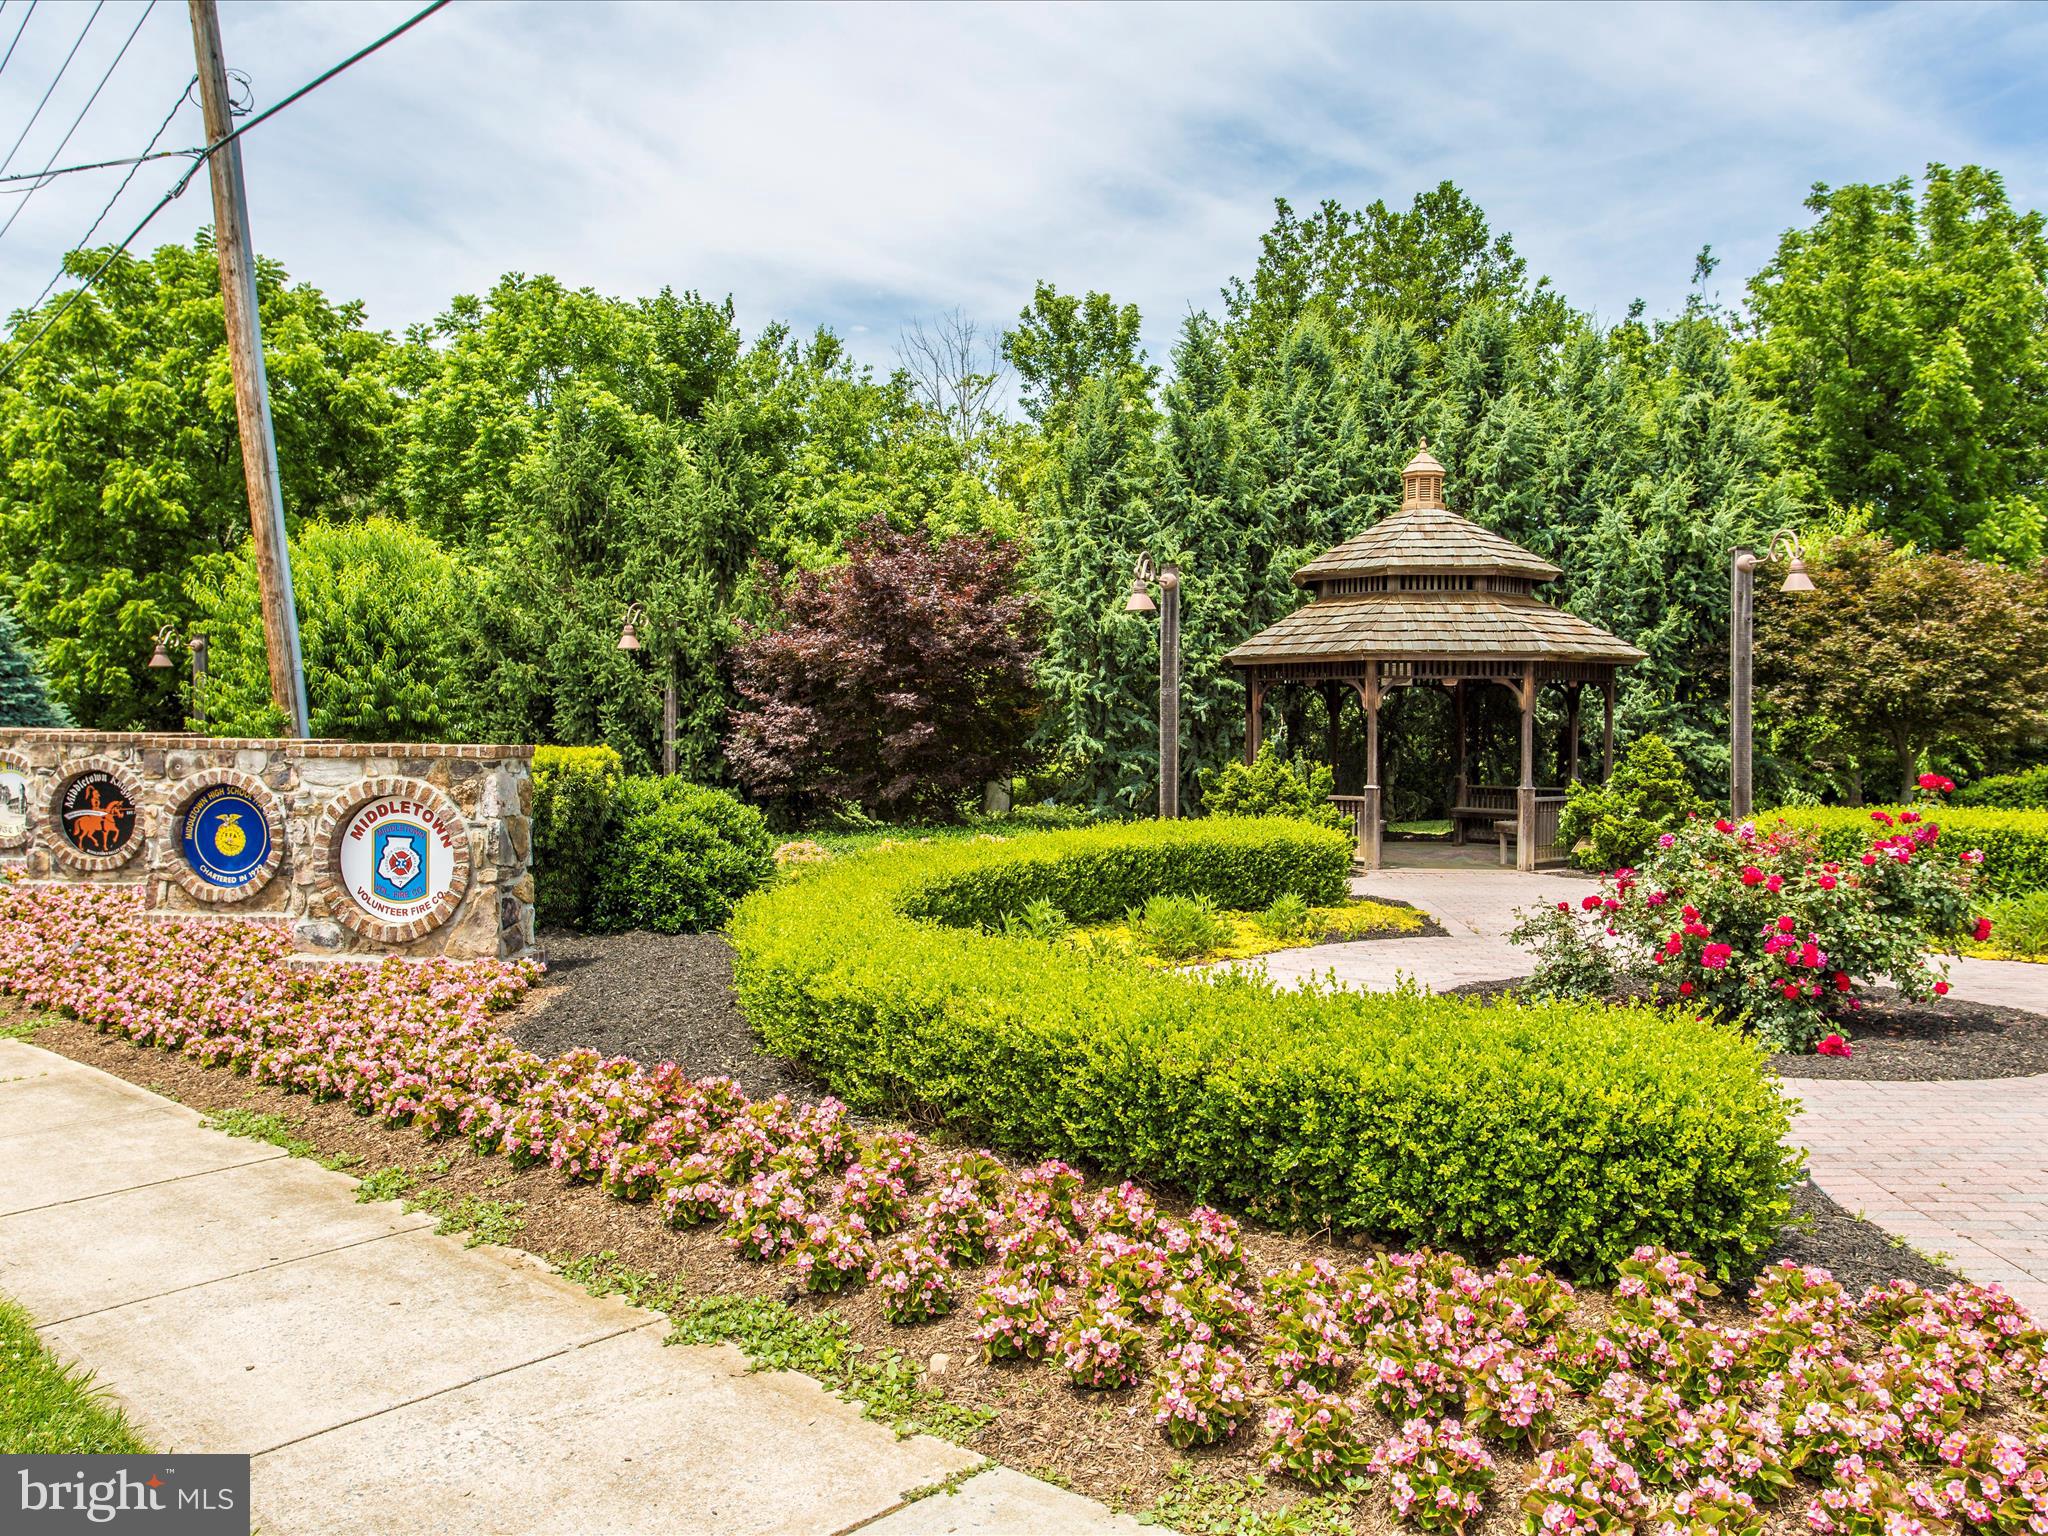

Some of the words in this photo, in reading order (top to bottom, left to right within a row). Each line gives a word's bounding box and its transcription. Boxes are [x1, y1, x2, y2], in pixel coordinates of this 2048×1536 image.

[64, 773, 108, 809] Middletown
[185, 796, 208, 840] MIDDLETOWN
[207, 787, 225, 801] HIGH
[350, 800, 453, 849] MIDDLETOWN
[377, 824, 425, 839] MIDDLETOWN
[200, 864, 237, 884] CHARTERED
[238, 874, 248, 883] IN
[357, 886, 409, 917] VOLUNTEER
[410, 900, 432, 916] FIRE
[393, 890, 409, 899] FIRE
